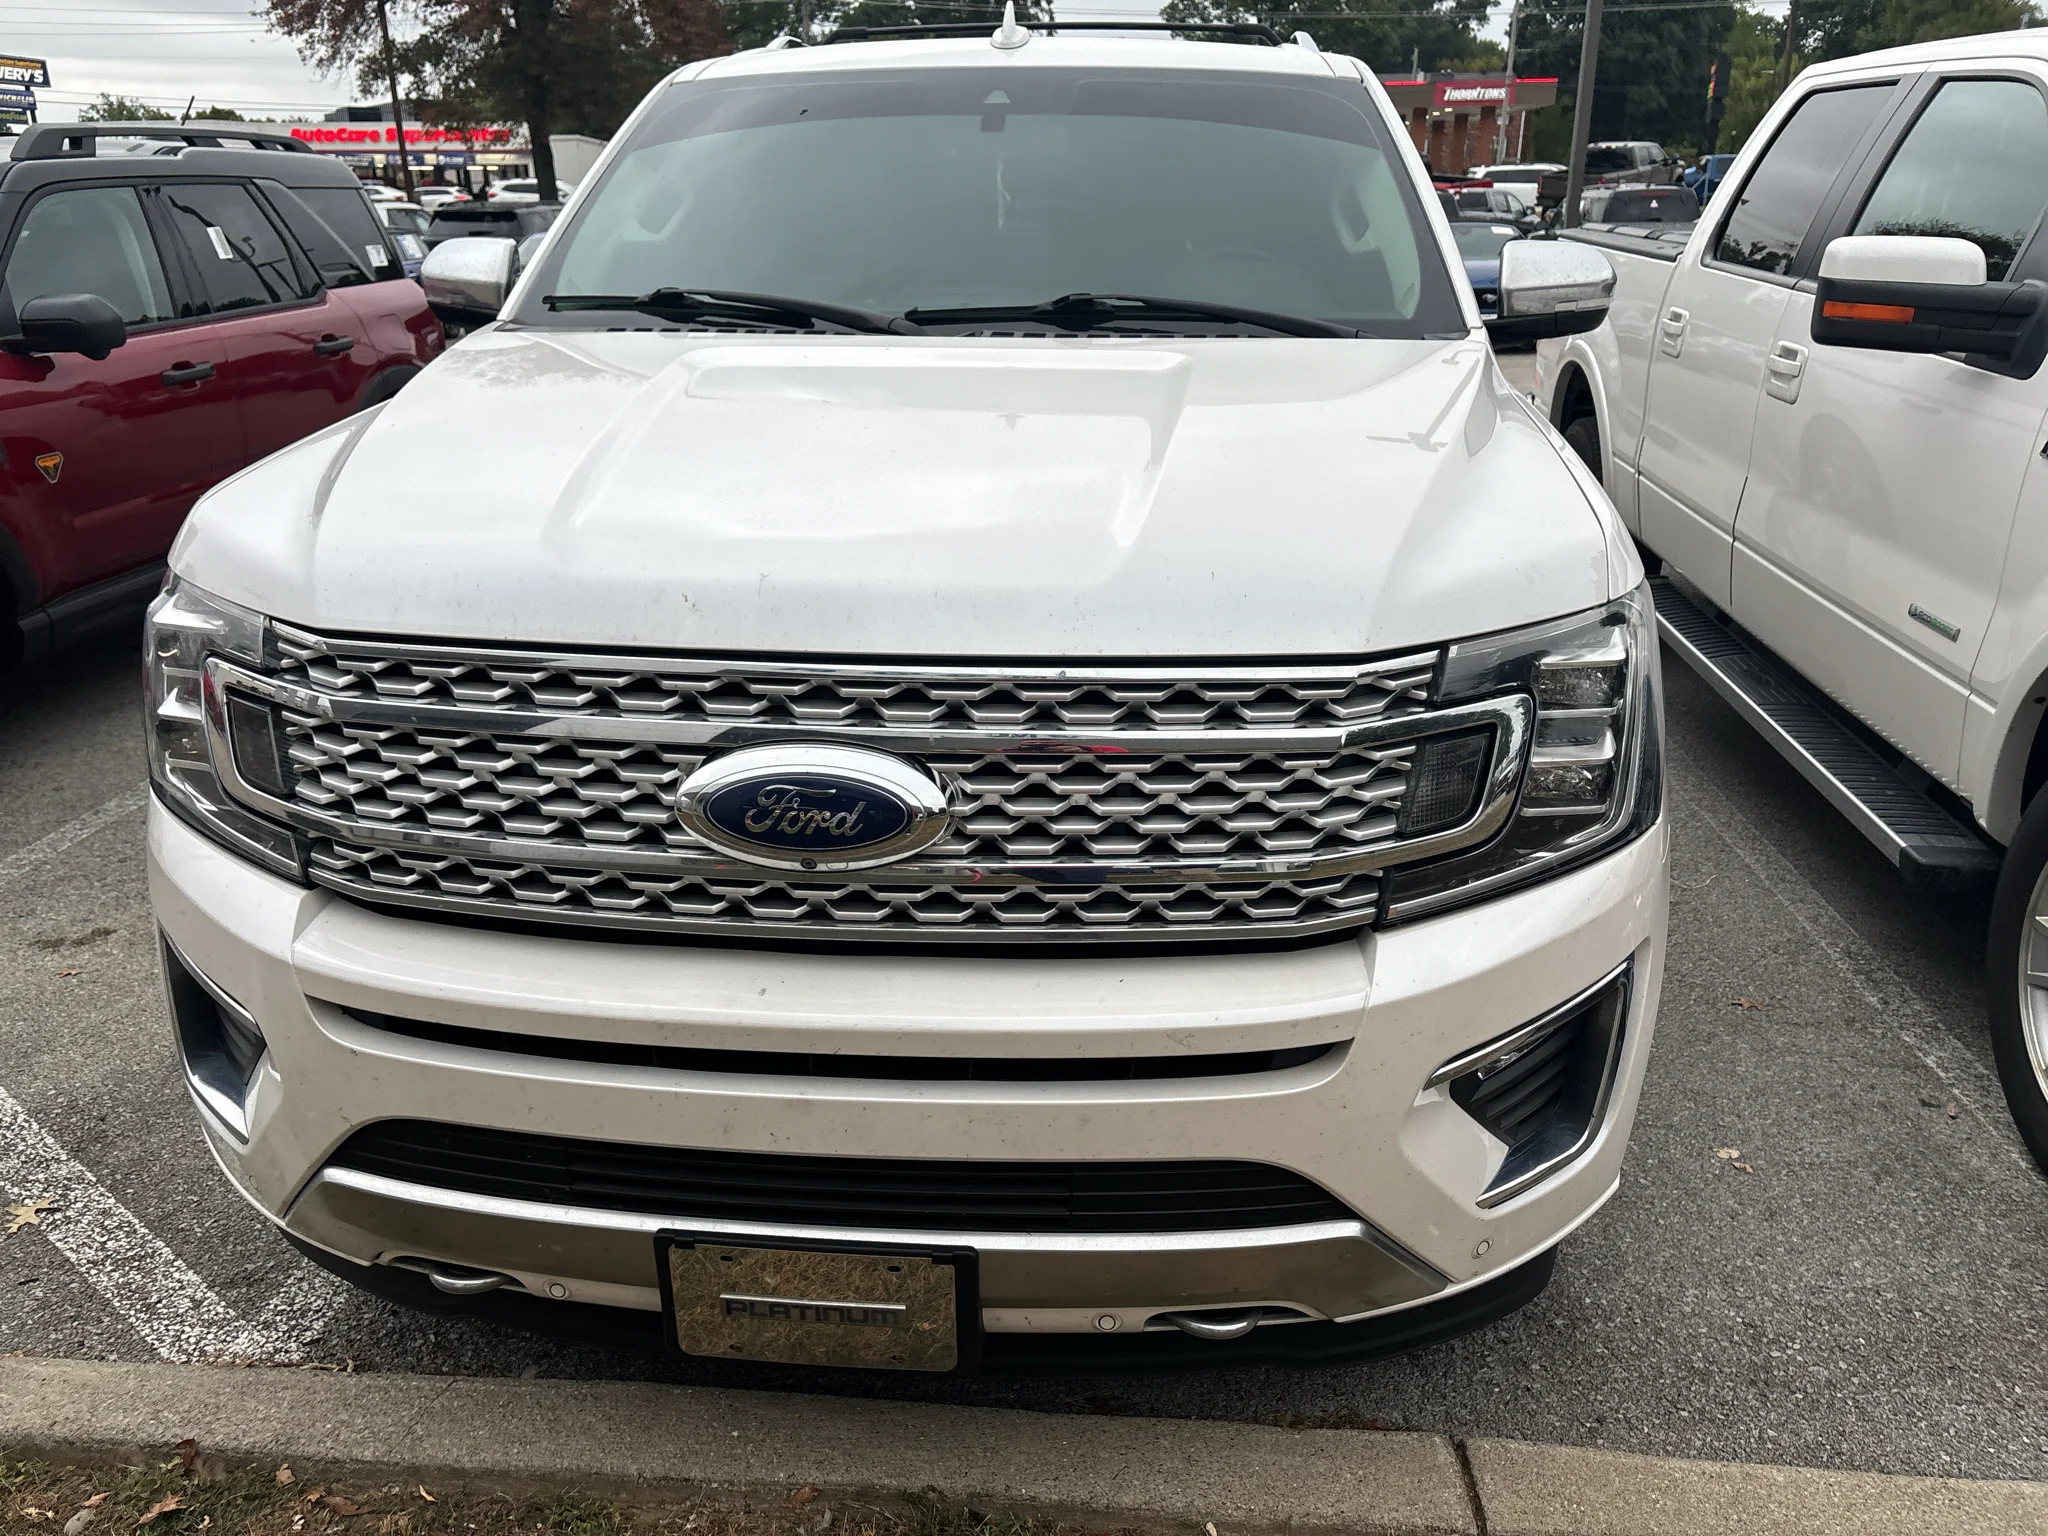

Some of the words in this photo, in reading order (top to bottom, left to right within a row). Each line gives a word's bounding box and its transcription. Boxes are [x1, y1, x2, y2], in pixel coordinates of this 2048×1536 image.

[290, 127, 380, 143] AutoCare
[744, 784, 867, 836] Ford
[724, 1299, 898, 1324] PLATINUM
